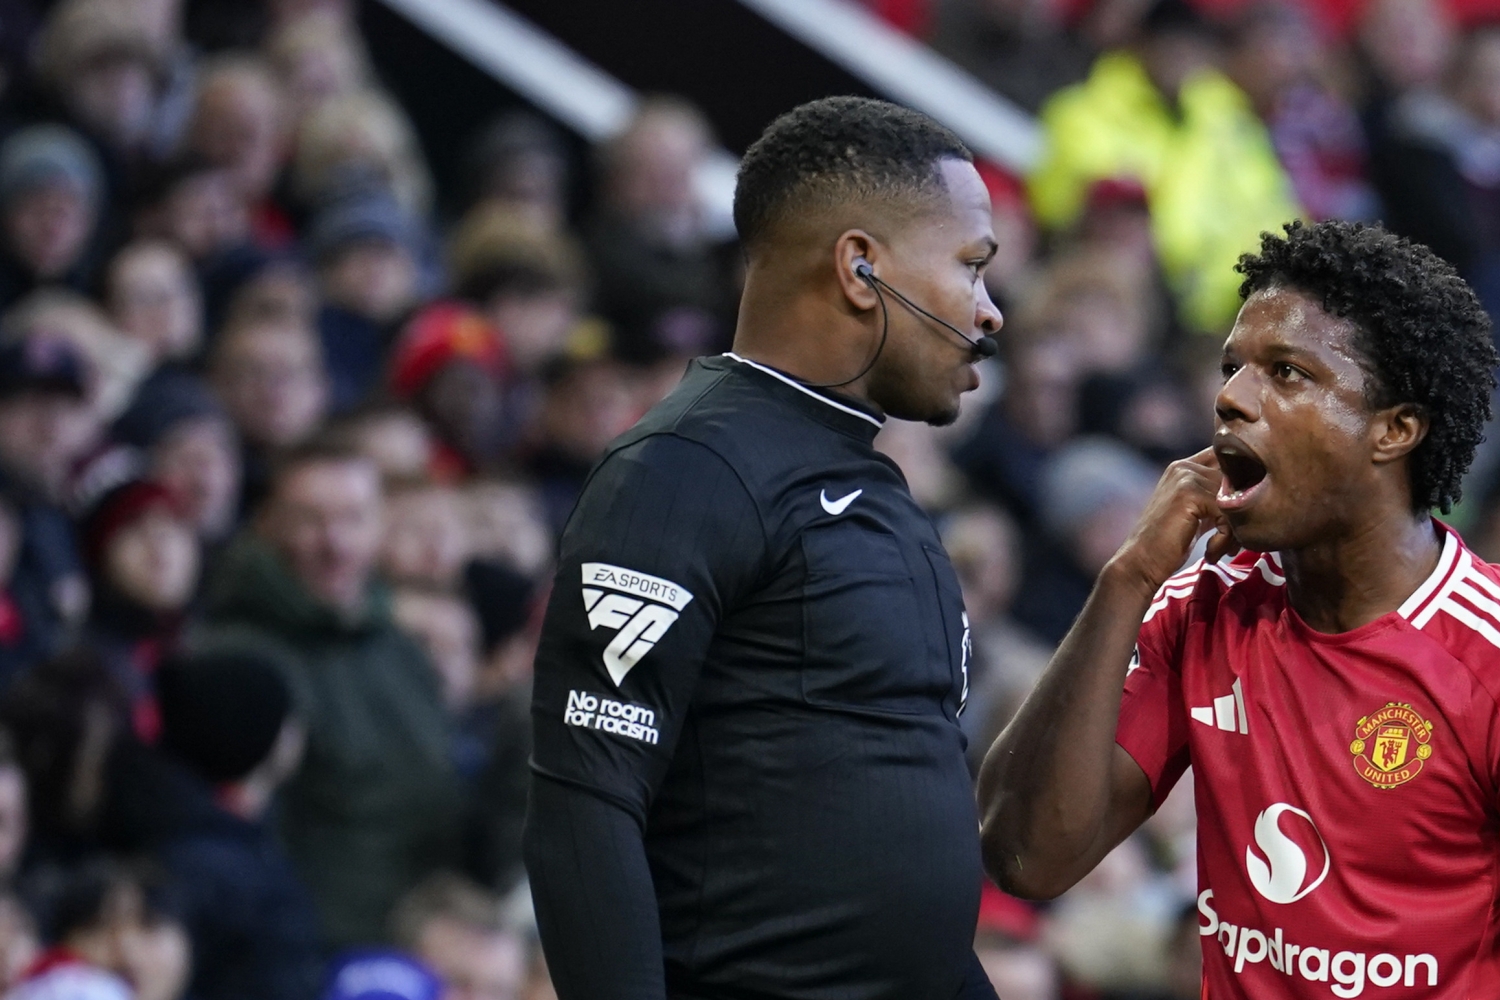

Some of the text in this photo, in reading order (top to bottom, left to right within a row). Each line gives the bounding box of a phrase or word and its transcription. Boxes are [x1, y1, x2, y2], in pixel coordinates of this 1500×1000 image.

[618, 573, 679, 602] SPORTS
[567, 690, 655, 726] No room
[1361, 709, 1427, 739] MANCHESTER
[564, 706, 659, 745] for racism
[1364, 766, 1411, 783] UNITED
[1197, 888, 1438, 999] Sapdragon
